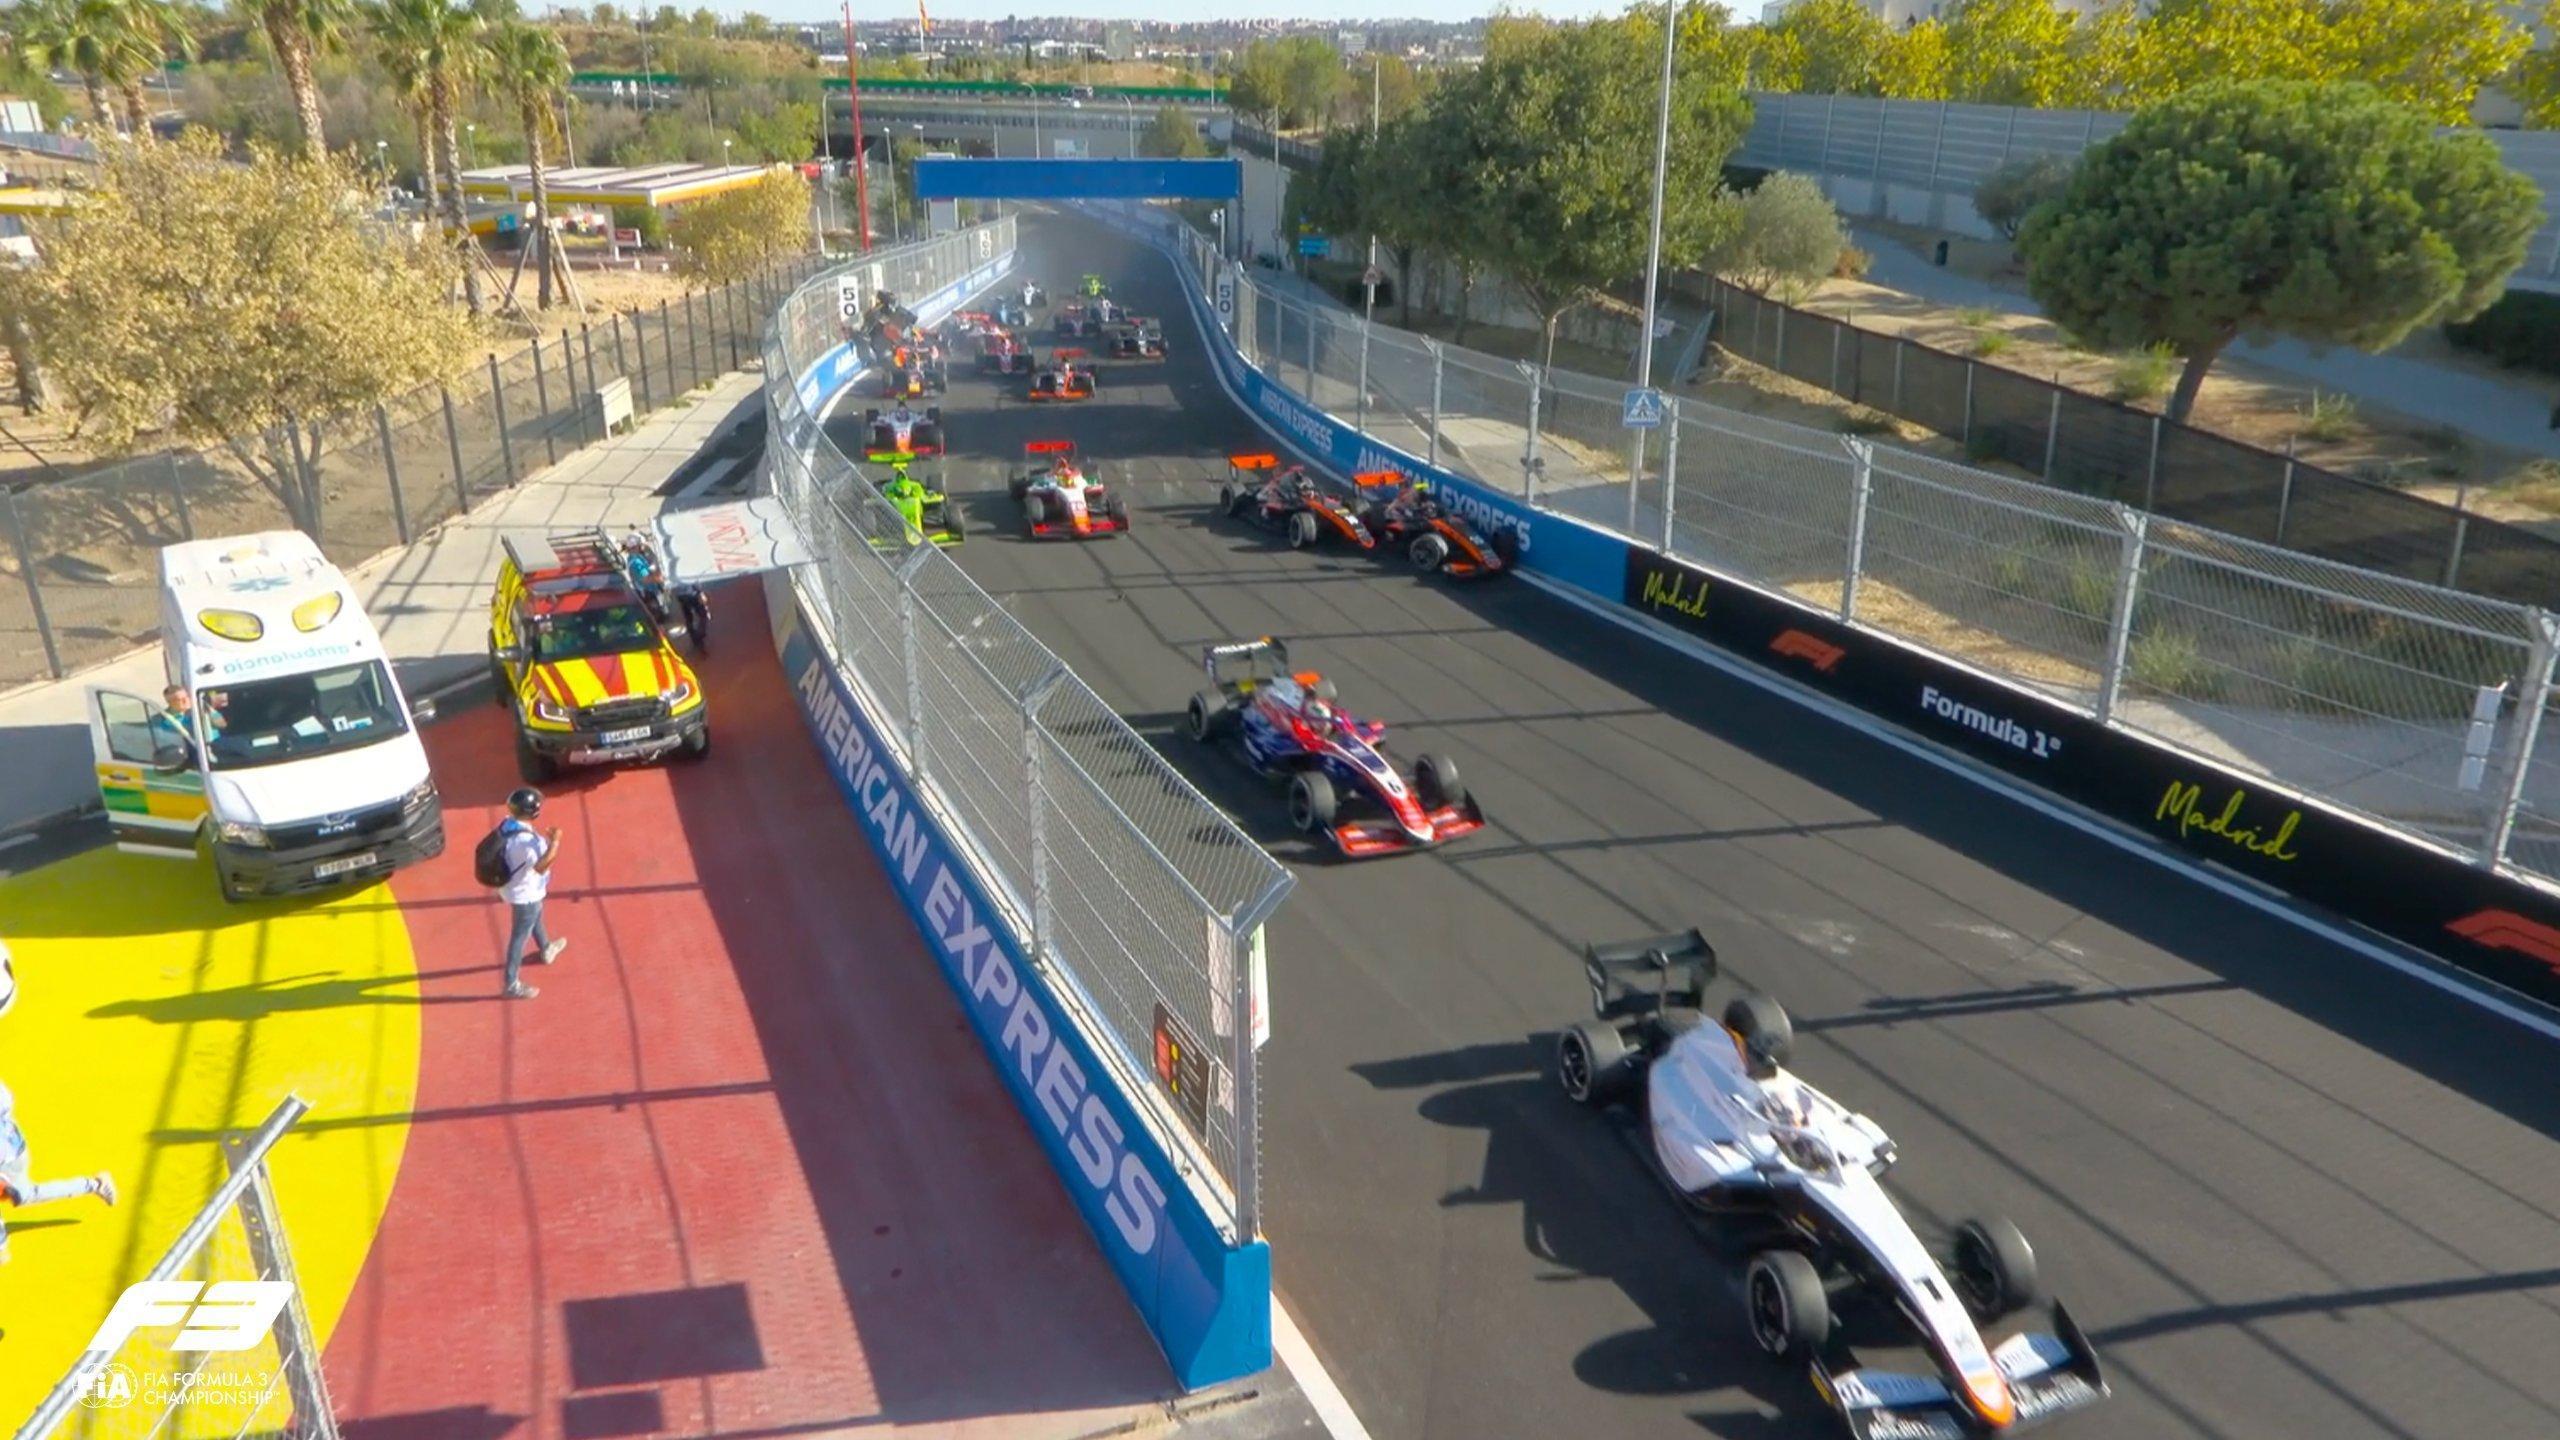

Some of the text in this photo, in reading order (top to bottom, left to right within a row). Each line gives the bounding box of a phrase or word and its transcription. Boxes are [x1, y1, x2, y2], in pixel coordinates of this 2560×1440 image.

[842, 286, 857, 317] 50
[1219, 284, 1231, 314] 50
[1643, 571, 1708, 618] Madrid
[1921, 685, 2028, 749] Formula
[2156, 780, 2301, 860] Madrid
[798, 658, 1167, 1255] AMERICAN EXPRESS
